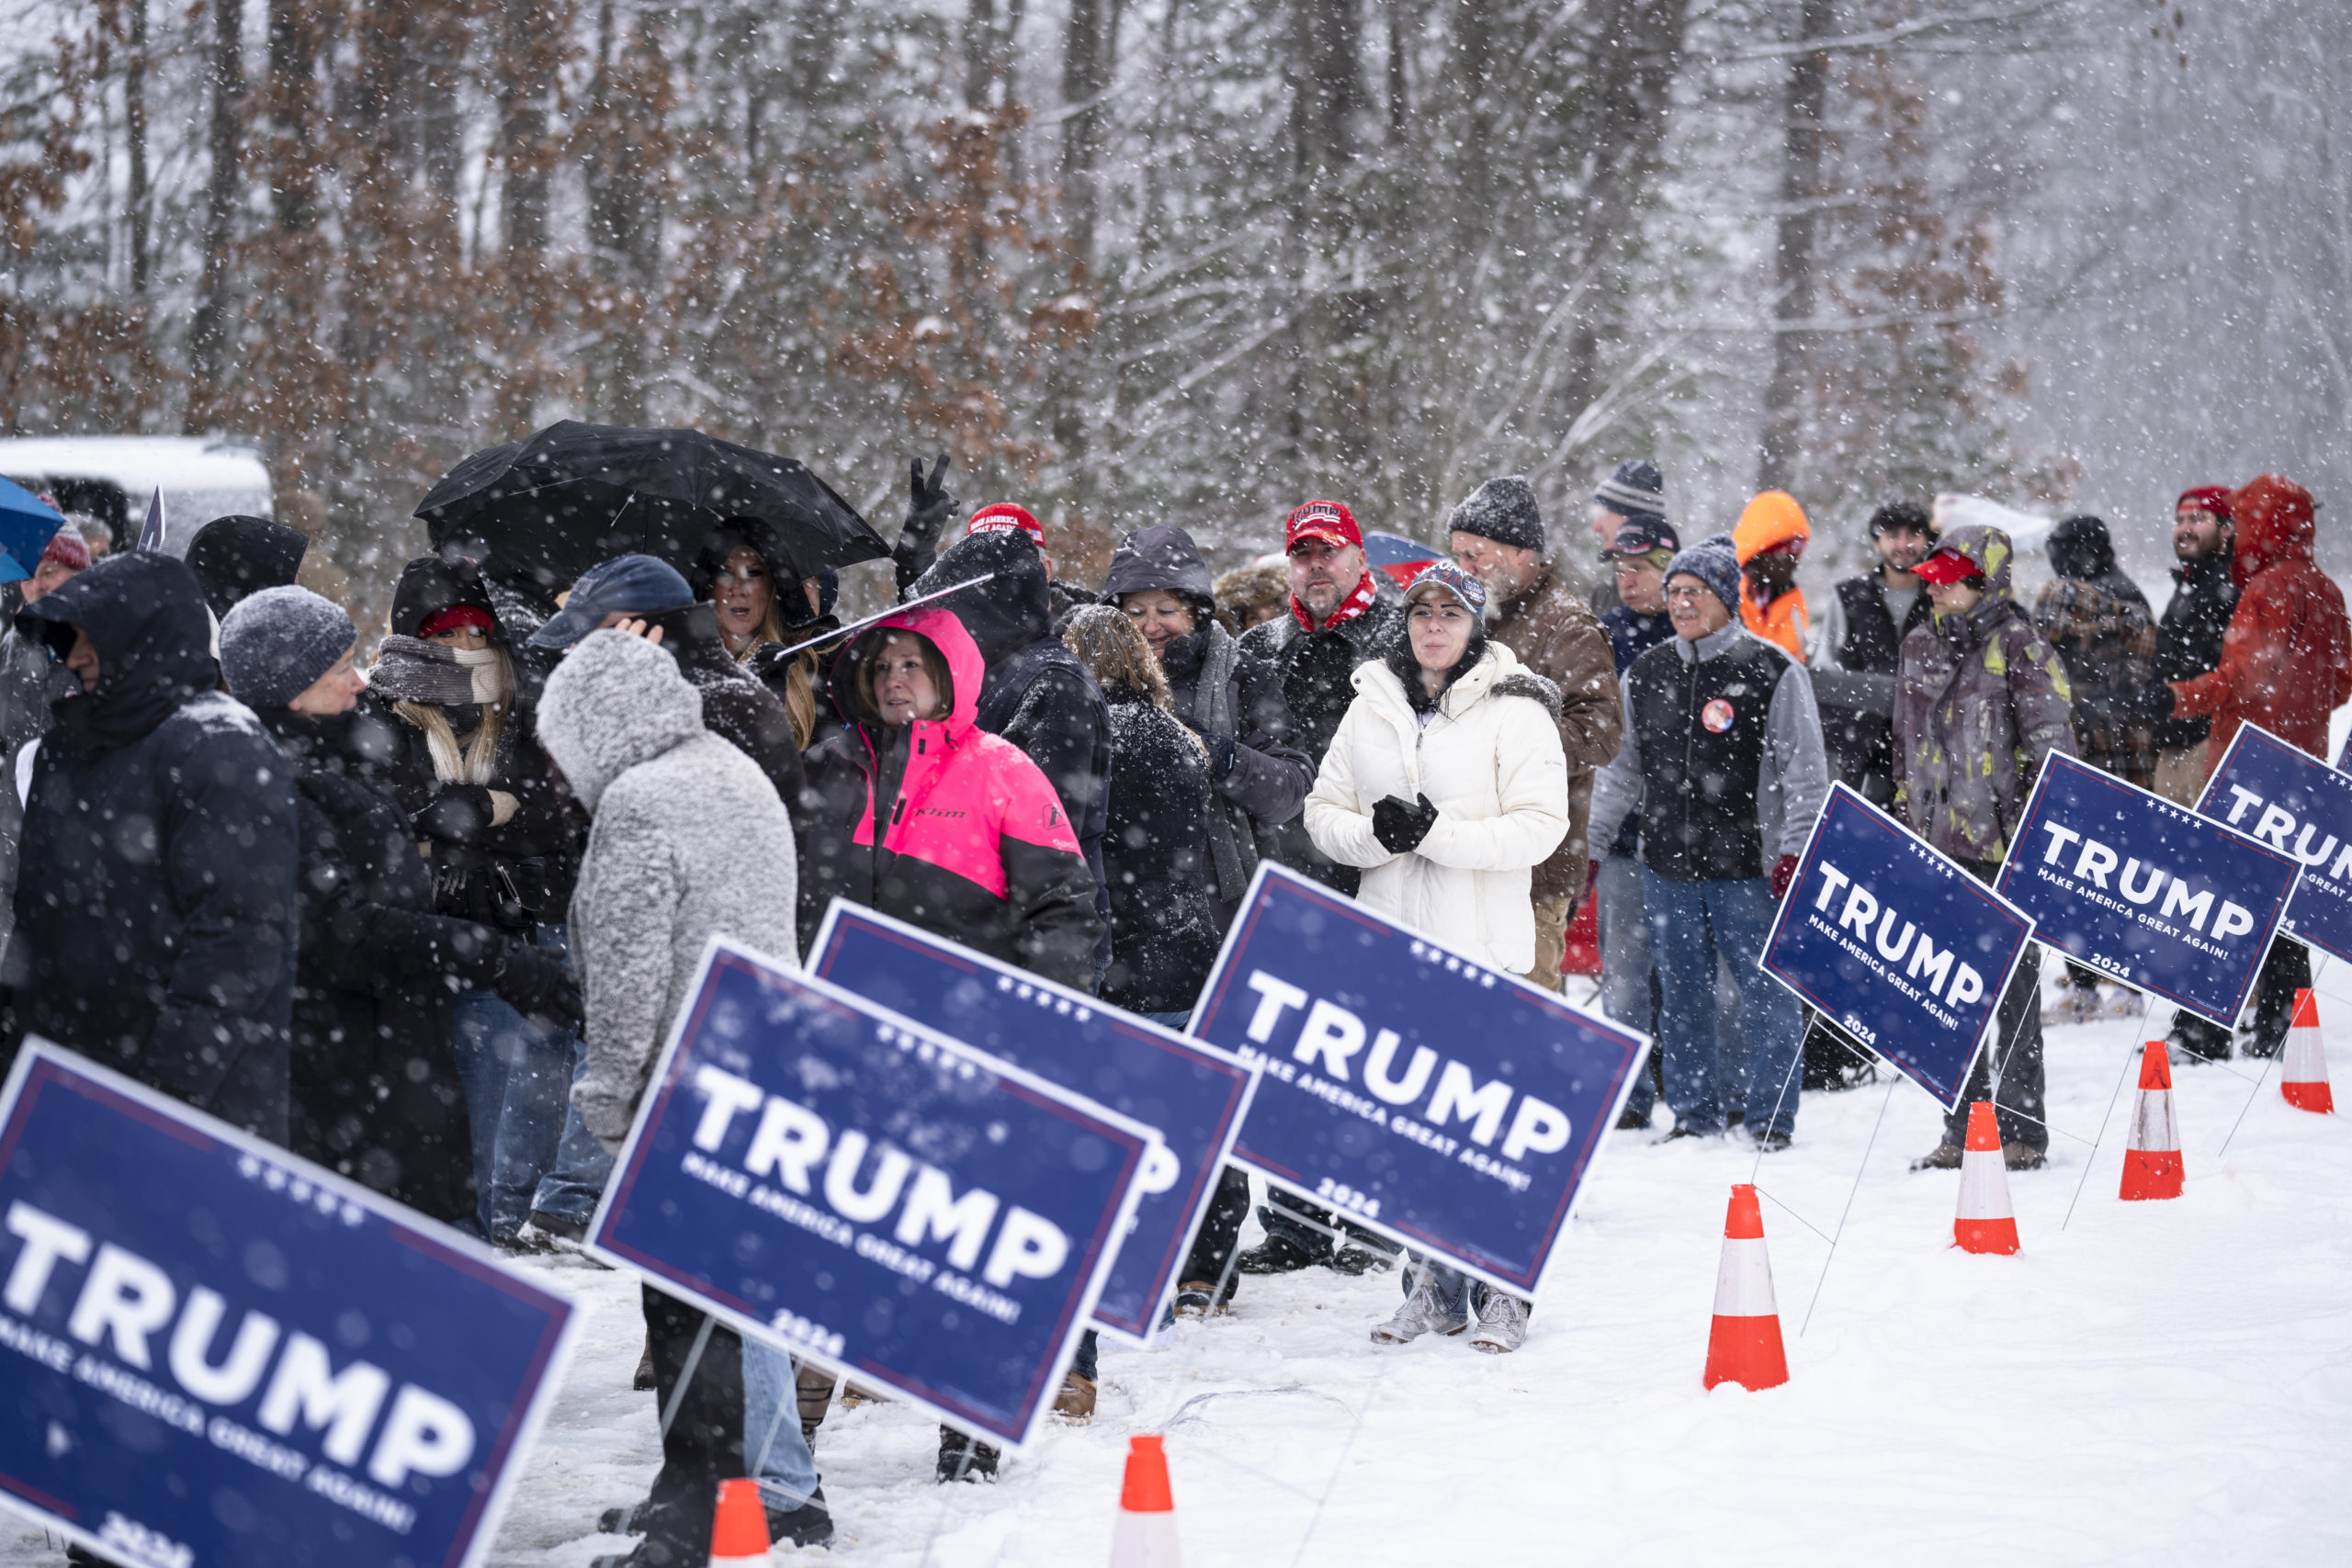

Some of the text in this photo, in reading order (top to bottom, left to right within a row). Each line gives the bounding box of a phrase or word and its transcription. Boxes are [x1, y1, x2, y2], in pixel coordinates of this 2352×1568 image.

[986, 515, 1019, 525] AMERICA
[1291, 504, 1340, 522] Trump
[2037, 867, 2229, 961] MAKE AMERICA GREAT AGAIN!
[2043, 819, 2256, 942] TRUMP
[2307, 873, 2346, 898] GREAT
[1808, 913, 1959, 1032] MAKE AMERICA GREAT AGAIN!
[1815, 860, 1984, 1009] TRUMP
[2090, 952, 2131, 979] 2024
[1247, 968, 1572, 1162] TRUMP
[1843, 1014, 1877, 1046] 2024
[692, 1063, 1071, 1292] TRUMP
[1296, 1073, 1387, 1125] AMERICA
[1391, 1115, 1458, 1156] GREAT
[1459, 1148, 1532, 1191] AGAIN!
[681, 1152, 1021, 1324] MAKE AMERICA GREAT AGAIN!
[1316, 1177, 1381, 1220] 2024
[5, 1199, 478, 1489] TRUMP
[771, 1309, 845, 1360] 2024
[74, 1354, 205, 1437] AMERICA
